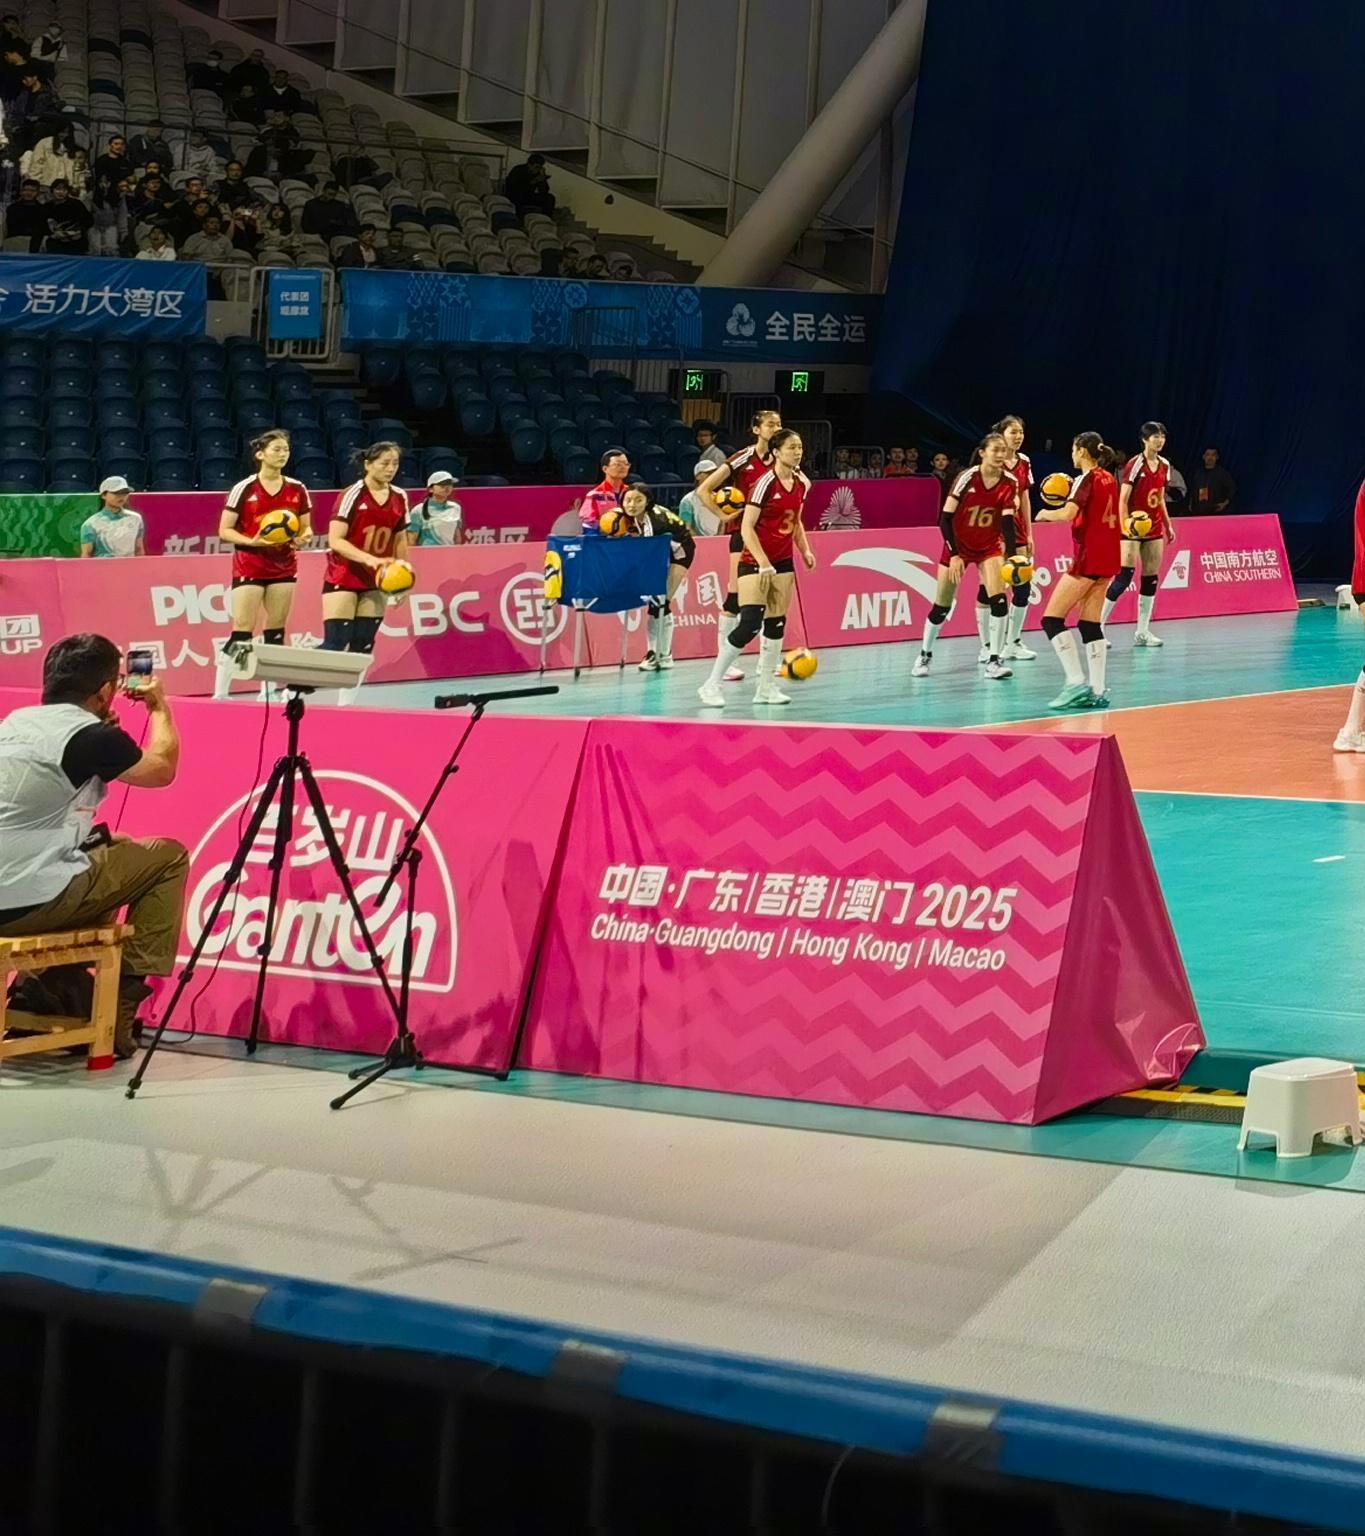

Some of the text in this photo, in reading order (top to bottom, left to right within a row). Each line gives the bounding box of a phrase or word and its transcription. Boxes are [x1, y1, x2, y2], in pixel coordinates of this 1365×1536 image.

[21, 283, 186, 318] 活力大湾区
[765, 310, 866, 343] 全民全运
[968, 504, 995, 528] 16
[1102, 495, 1117, 529] 4
[362, 524, 392, 554] 10
[1200, 549, 1279, 570] 中国南方航空
[1203, 568, 1282, 584] CHINA SOUTHERN
[840, 590, 913, 631] ANTA
[915, 883, 1018, 932] 2025
[790, 928, 850, 966] Hong
[853, 932, 913, 970] Kong
[928, 938, 1006, 971] Macao
